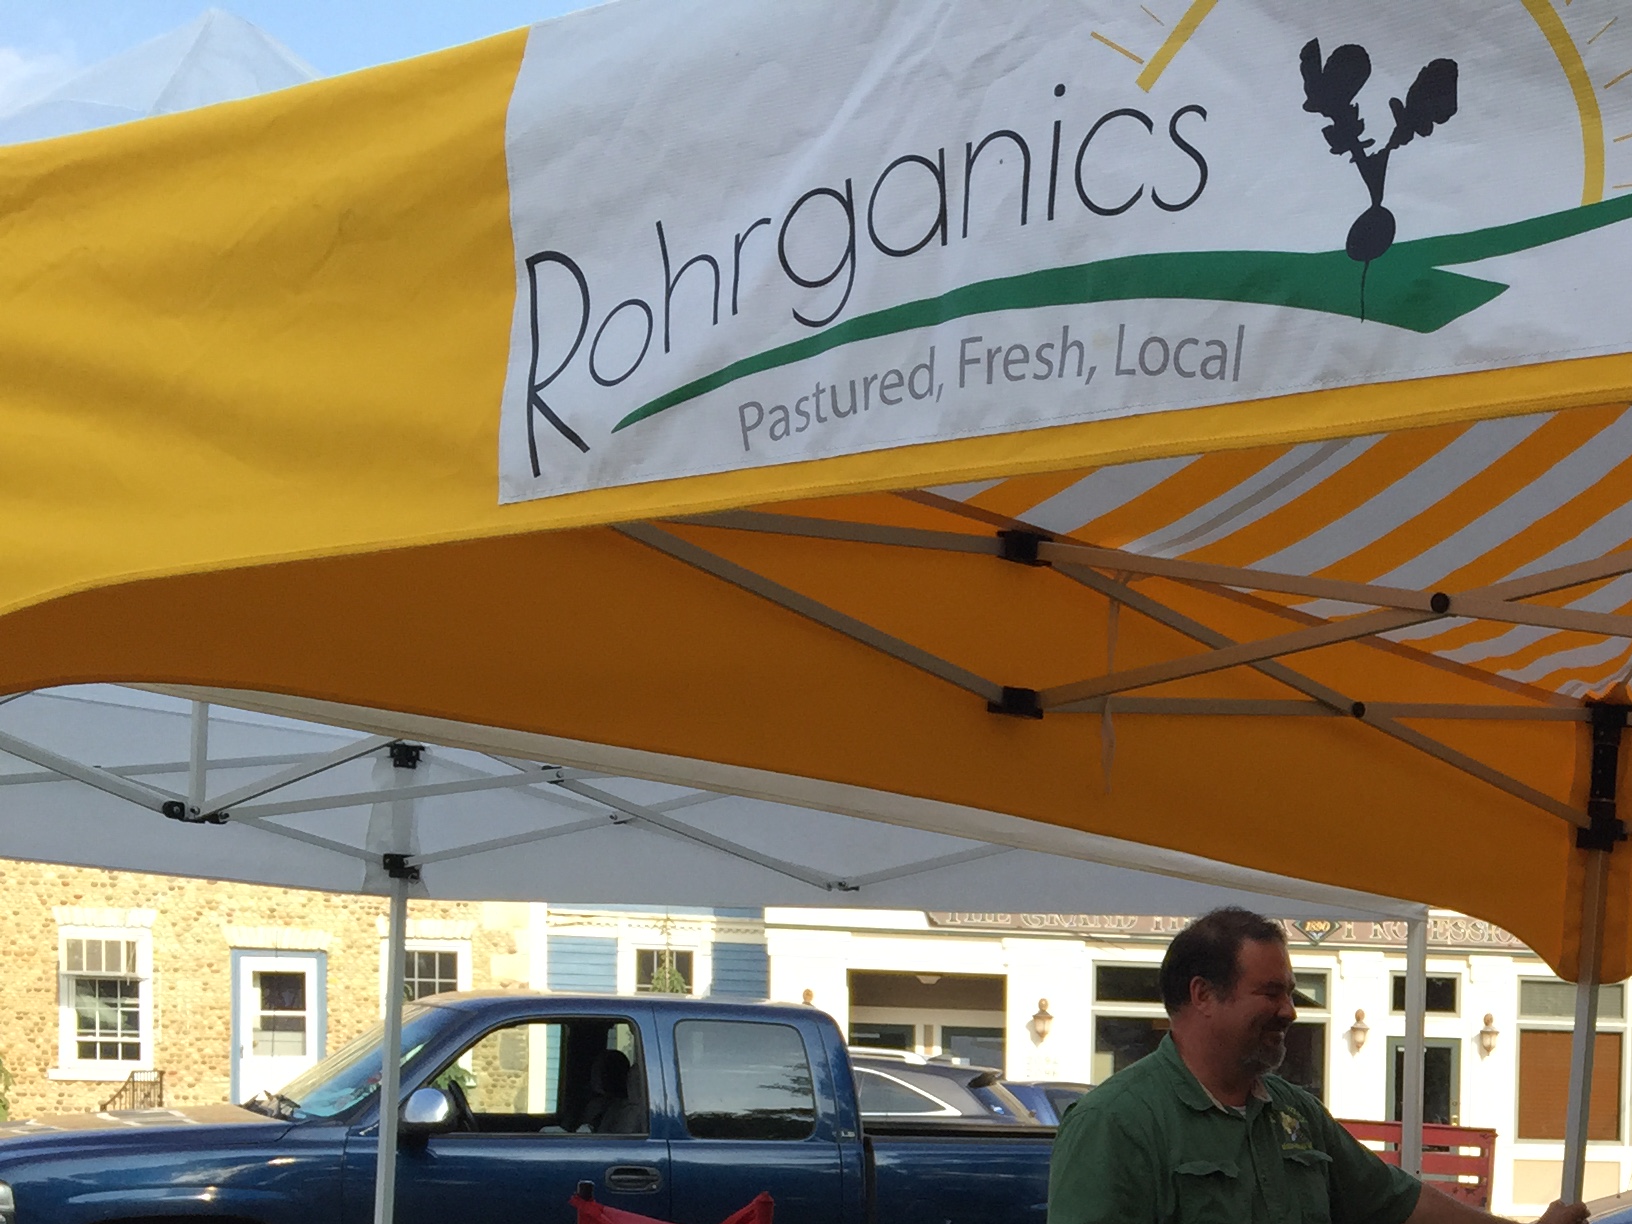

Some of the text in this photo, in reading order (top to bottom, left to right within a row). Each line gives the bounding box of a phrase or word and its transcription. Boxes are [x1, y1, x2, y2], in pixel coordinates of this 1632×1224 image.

[526, 83, 1208, 477] Rohrganics
[738, 323, 1245, 451] Pastured, Fresh, Local
